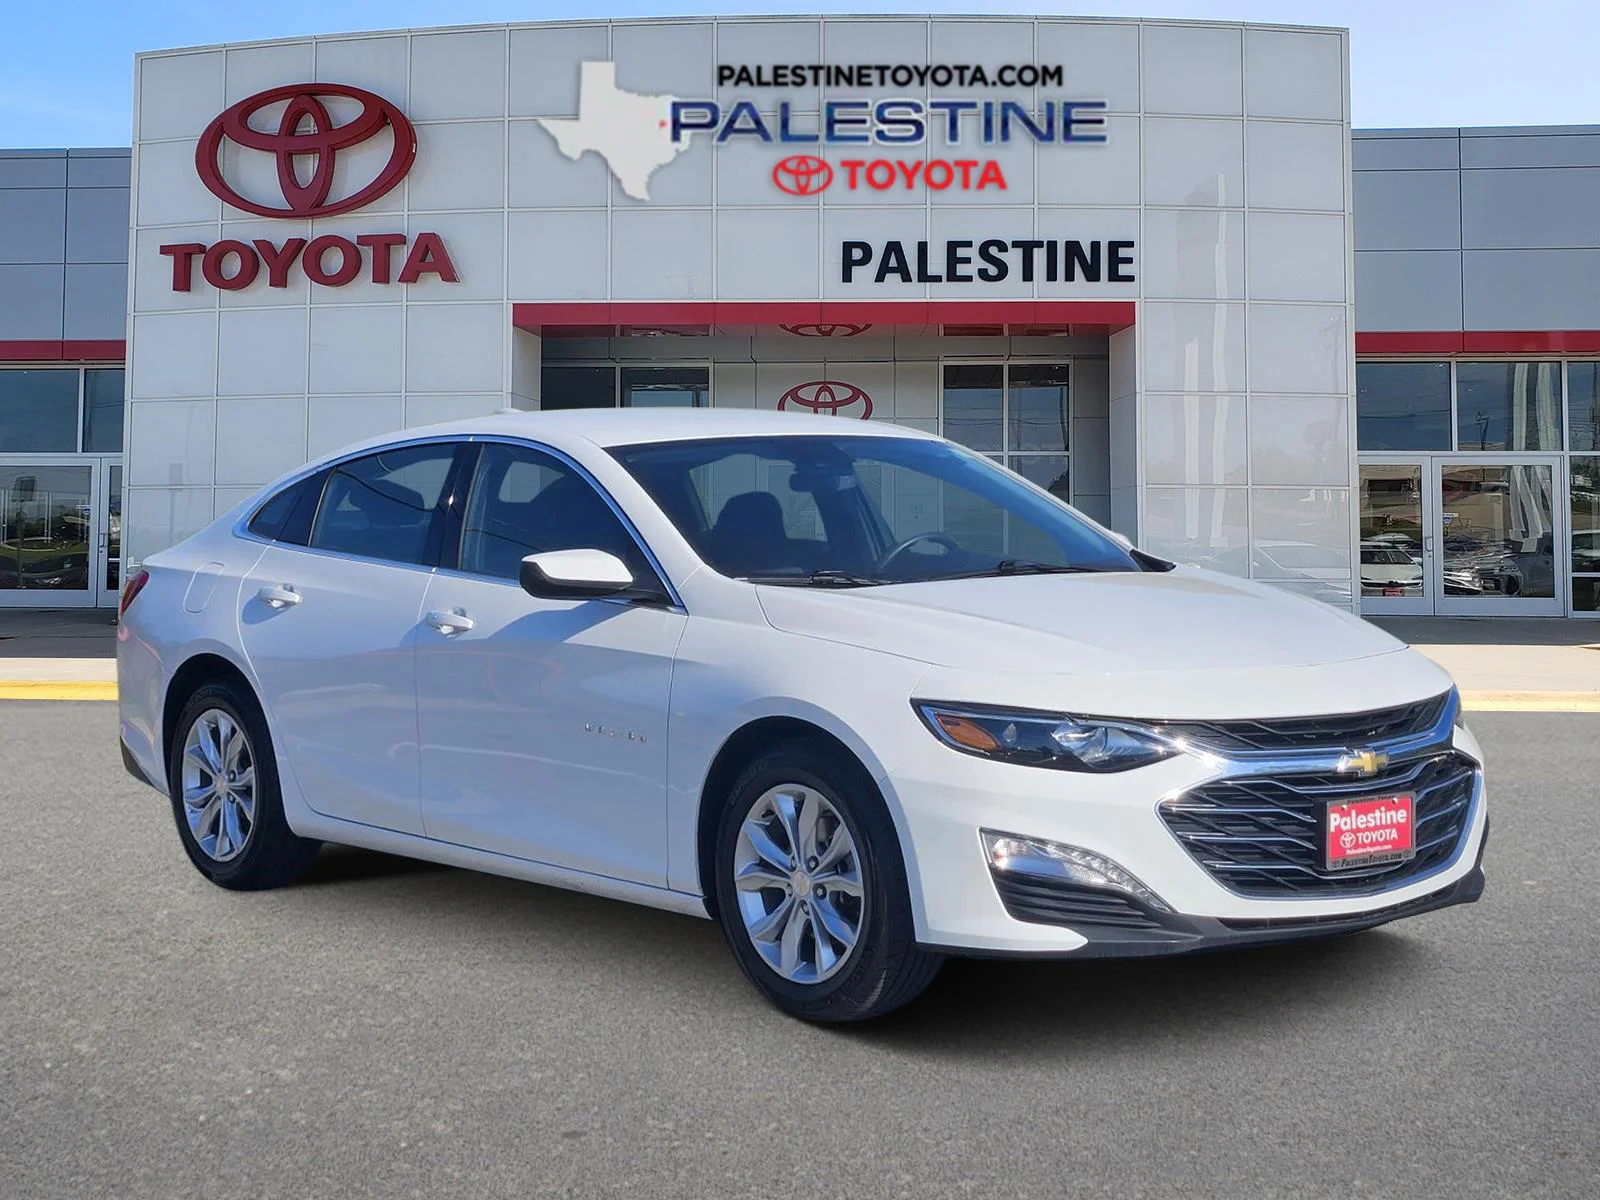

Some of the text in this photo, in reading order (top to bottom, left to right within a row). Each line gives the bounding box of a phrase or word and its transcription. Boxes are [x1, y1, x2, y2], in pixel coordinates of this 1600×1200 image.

[160, 232, 460, 292] TOYOTA
[842, 239, 1135, 283] PALESTINE
[1330, 806, 1407, 832] Palestine
[1356, 828, 1399, 844] TOYOTA
